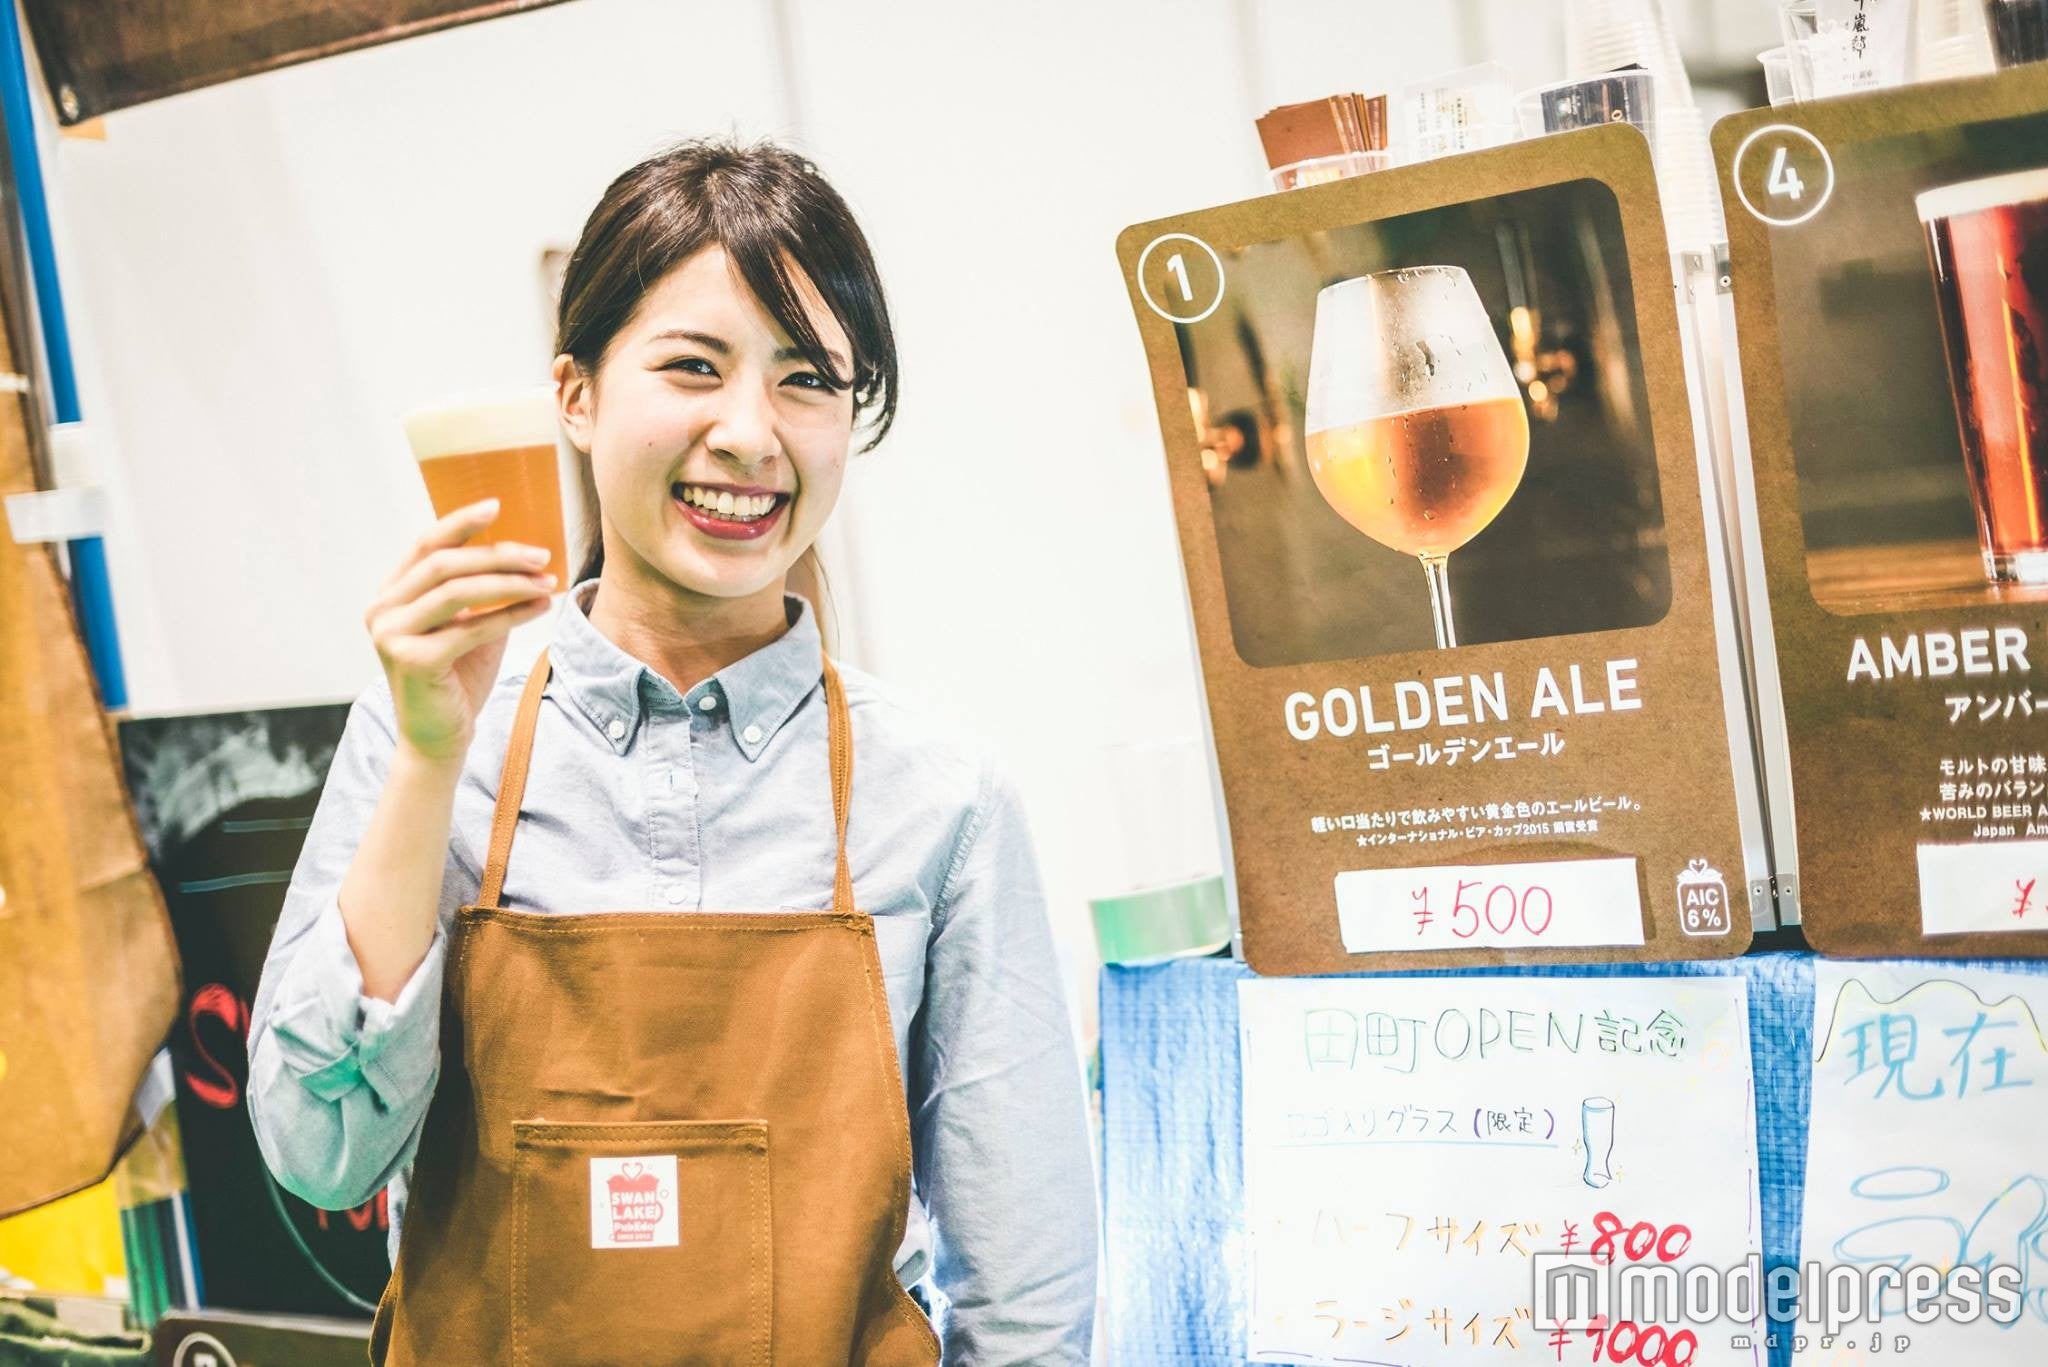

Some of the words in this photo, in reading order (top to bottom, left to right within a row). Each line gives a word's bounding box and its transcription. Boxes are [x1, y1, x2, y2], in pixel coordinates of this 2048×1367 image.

[1767, 147, 1804, 200] 4
[1166, 253, 1193, 302] 1
[1847, 627, 2031, 682] AMBER
[1284, 671, 1510, 742] GOLDEN
[1530, 658, 1643, 717] ALE
[1366, 732, 1566, 771] ゴールデンエール
[1939, 754, 2048, 776] モルトの甘味
[1933, 805, 1987, 820] WORLD
[1992, 804, 2033, 819] BEER
[1973, 824, 2016, 839] Japan
[1411, 879, 1555, 939] ¥500
[1686, 888, 1720, 906] AIC
[1687, 908, 1722, 928] 6%
[1844, 1011, 2034, 1100] 現在
[611, 1191, 656, 1205] SWAN
[612, 1206, 656, 1220] LAKE
[1314, 1298, 1533, 1350] ラージサイズ
